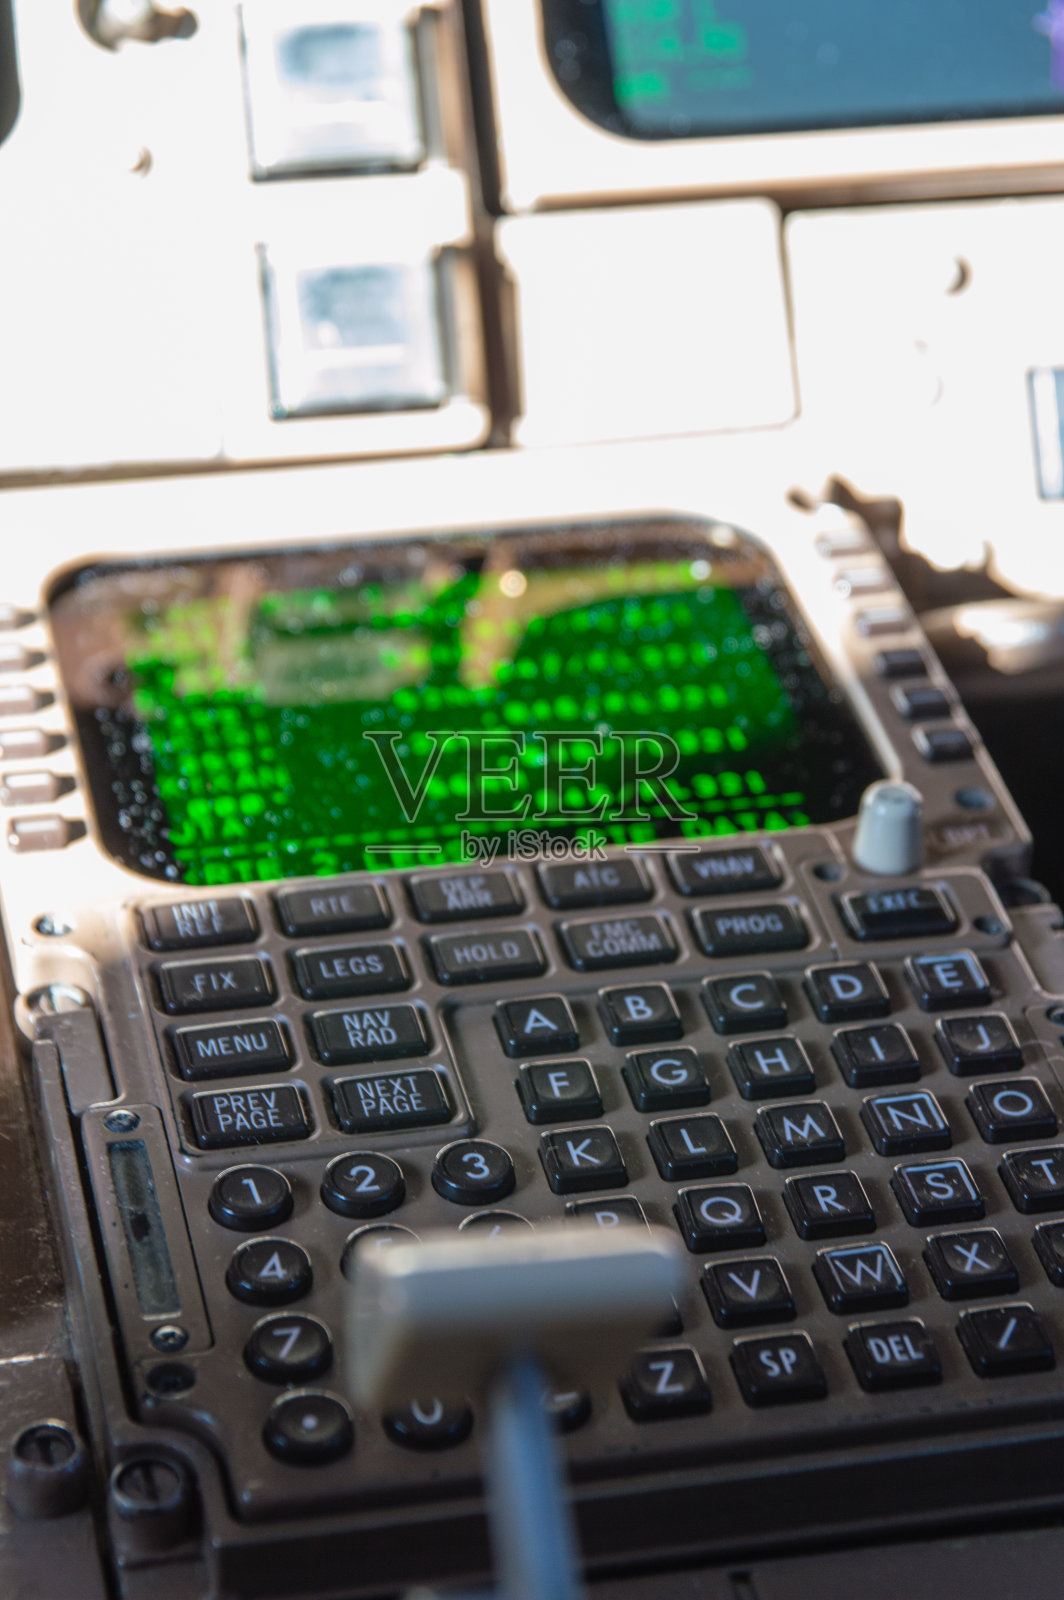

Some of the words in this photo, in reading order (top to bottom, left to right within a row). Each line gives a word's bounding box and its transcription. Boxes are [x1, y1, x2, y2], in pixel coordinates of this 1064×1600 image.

[695, 856, 756, 878] VNAV
[310, 896, 357, 916] RTE
[716, 914, 785, 937] PROG
[454, 942, 521, 965] HOLD
[319, 956, 385, 979] LEGS
[934, 962, 964, 989] E
[194, 972, 238, 994] FIX
[730, 983, 759, 1009] C
[829, 974, 864, 1000] D
[524, 1008, 559, 1033] A
[625, 995, 654, 1020] B
[343, 1011, 391, 1032] NAV
[196, 1033, 268, 1058] MENU
[349, 1028, 398, 1049] RAD
[869, 1035, 886, 1061] I
[974, 1024, 993, 1051] J
[650, 1059, 689, 1085] G
[754, 1047, 792, 1074] H
[356, 1076, 418, 1100] NEXT
[547, 1072, 571, 1098] F
[213, 1091, 277, 1115] PREV
[362, 1095, 427, 1118] PAGE
[887, 1102, 927, 1131] N
[993, 1089, 1034, 1117] O
[218, 1110, 284, 1133] PAGE
[783, 1114, 826, 1142] M
[566, 1138, 602, 1167] K
[680, 1127, 707, 1155] L
[349, 1165, 380, 1193] 2
[461, 1152, 490, 1179] 3
[1031, 1158, 1057, 1186] T
[241, 1177, 263, 1204] 1
[812, 1185, 846, 1213] R
[925, 1172, 954, 1200] S
[700, 1196, 745, 1224] Q
[258, 1251, 287, 1280] 4
[953, 1241, 991, 1271] X
[834, 1253, 883, 1287] W
[728, 1269, 761, 1299] V
[272, 1326, 302, 1359] 7
[868, 1334, 924, 1364] DEL
[759, 1347, 797, 1378] SP
[649, 1361, 683, 1395] Z
